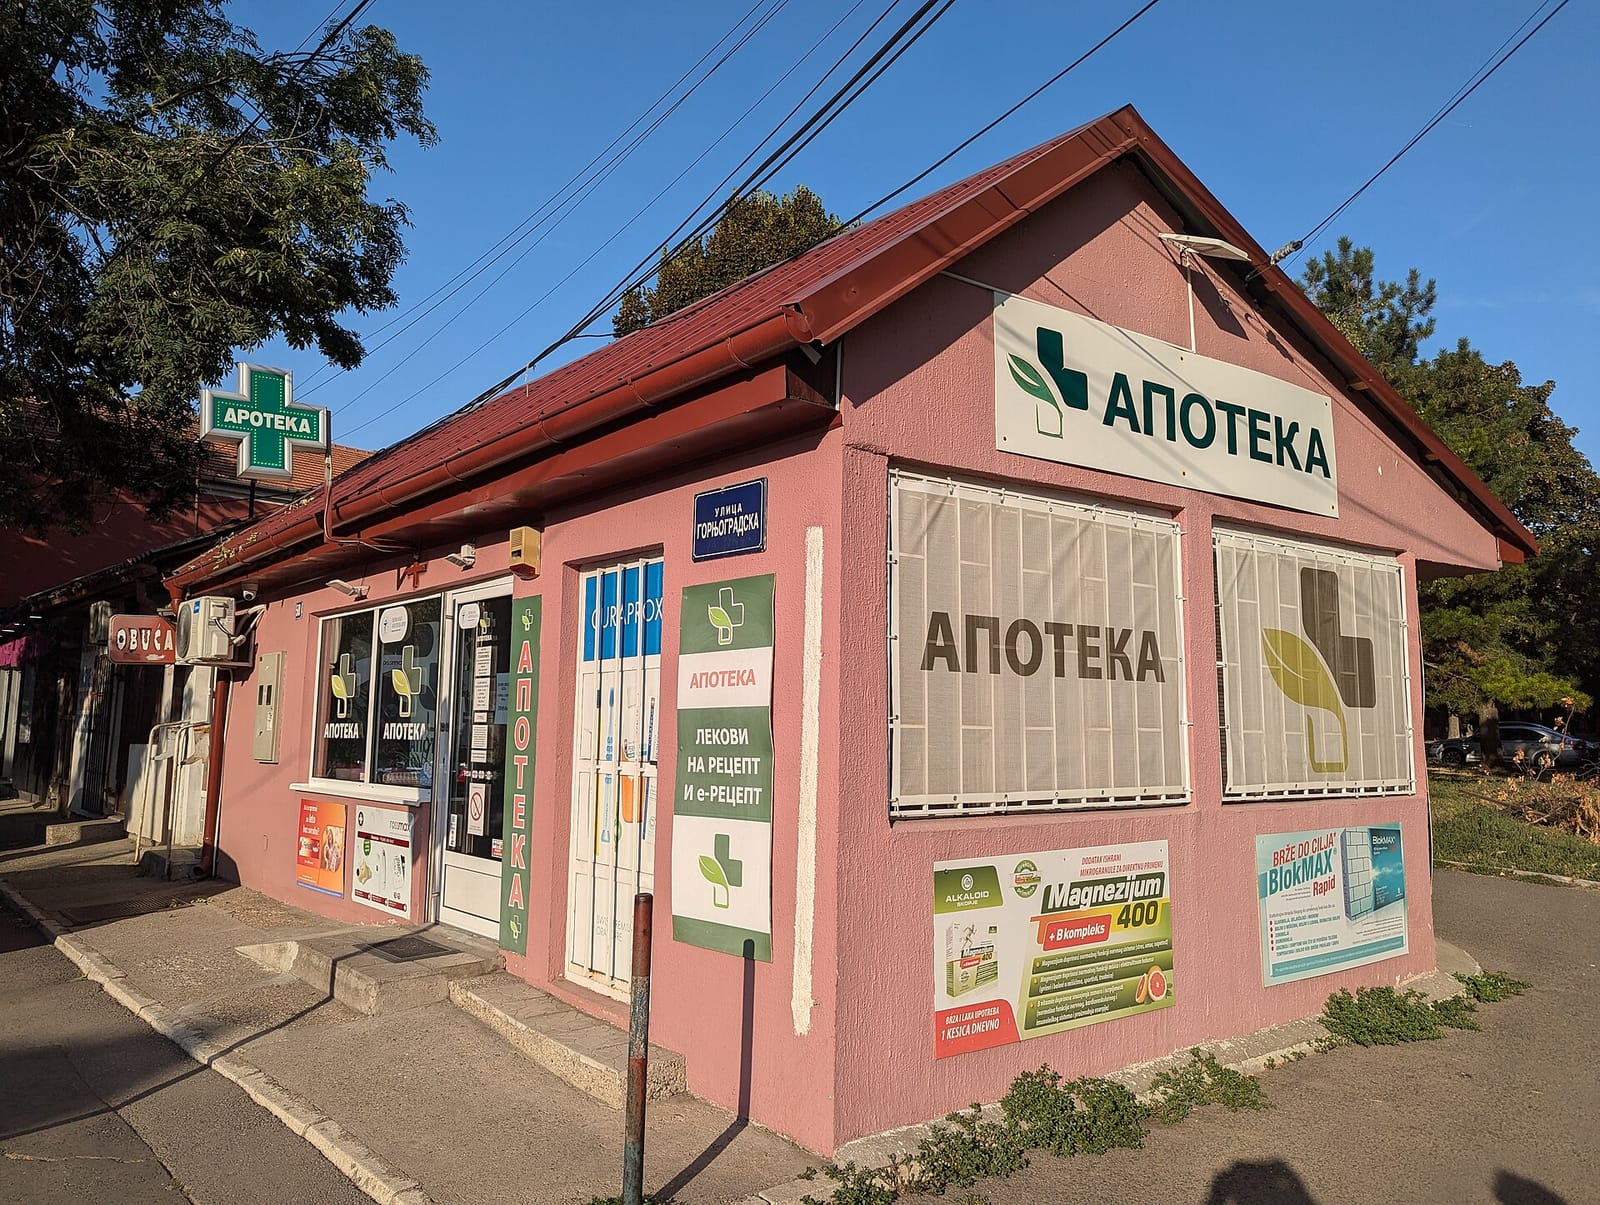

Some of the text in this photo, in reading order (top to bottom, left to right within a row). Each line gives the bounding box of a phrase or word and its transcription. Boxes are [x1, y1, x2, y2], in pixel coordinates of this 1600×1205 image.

[223, 407, 311, 434] APOTEKA
[1102, 372, 1332, 479] АПОТЕКА
[714, 502, 743, 518] УЛИЦА
[696, 512, 759, 540] ГОРЊОГРАДСКА
[116, 623, 173, 651] OBUĆA
[920, 611, 1166, 684] АПОТЕКА
[690, 669, 756, 689] АПОТЕКА
[324, 723, 359, 739] АПОТЕКА
[696, 728, 749, 745] ЛЕКОВИ
[507, 640, 534, 910] АПОТЕКА
[687, 756, 761, 777] НА РЕЦЕПТ
[684, 784, 763, 807] И е-РЕЦЕПТ
[1082, 854, 1122, 865] DODATAK ISHRANI
[1273, 843, 1296, 867] BRŽE
[1297, 841, 1310, 859] DO
[945, 890, 990, 903] ALKALOID
[1047, 874, 1161, 911] Magnezijum
[1313, 875, 1336, 897] Rapid
[1117, 900, 1159, 928] 400
[962, 1011, 975, 1022] LAKA
[941, 1018, 1000, 1041] 1 KESICA DNEVNO
